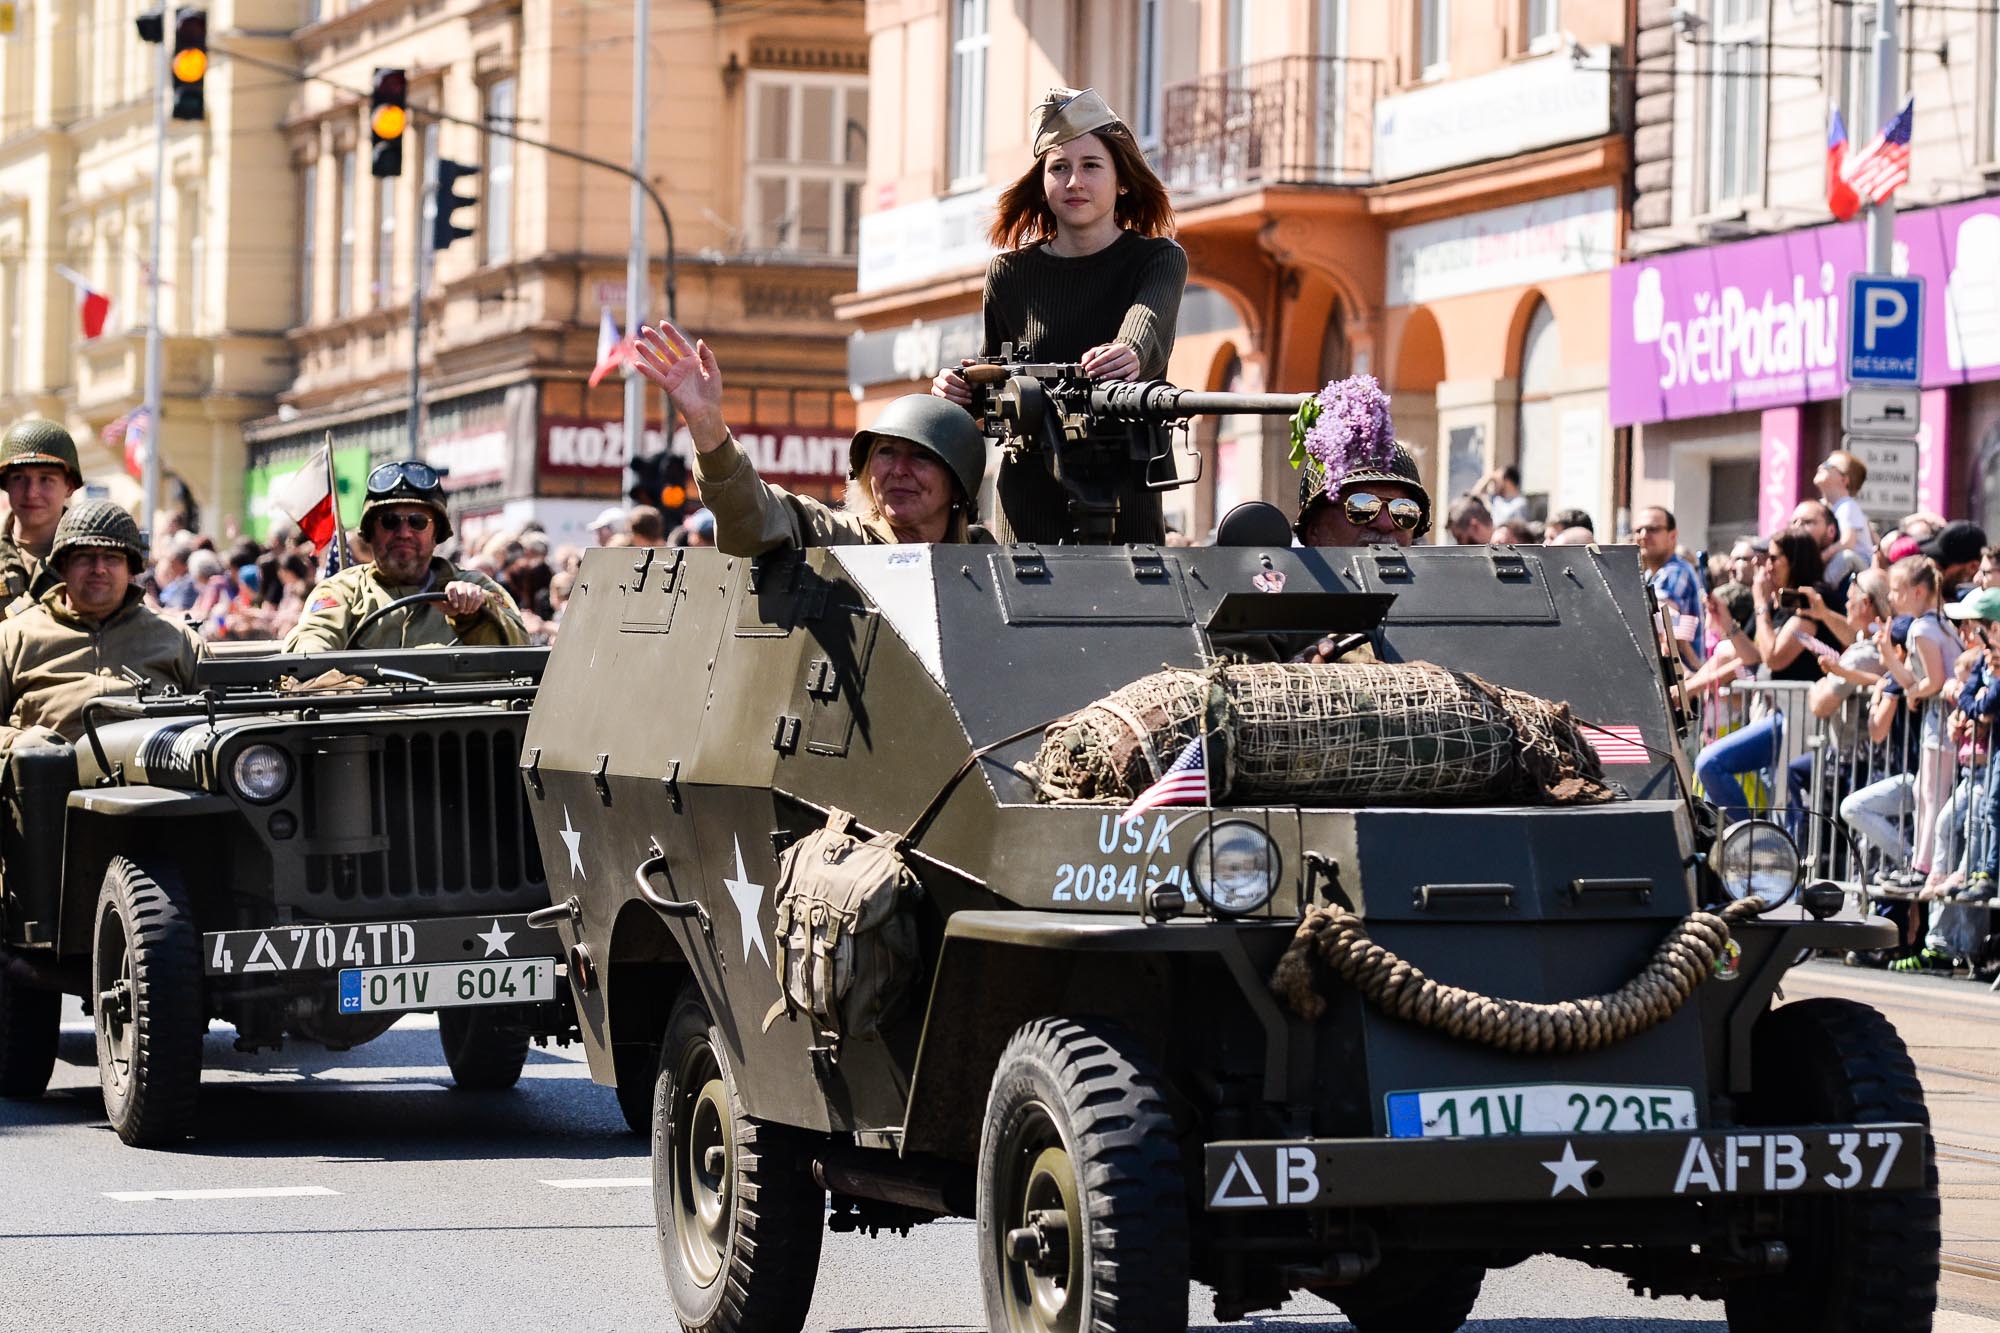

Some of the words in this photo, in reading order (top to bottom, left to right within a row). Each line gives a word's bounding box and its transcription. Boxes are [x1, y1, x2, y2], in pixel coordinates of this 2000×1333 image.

[1660, 261, 1839, 389] světPotahů
[1864, 287, 1908, 350] P
[1098, 814, 1171, 854] USA
[343, 997, 360, 1008] CZ
[370, 971, 430, 1006] 01V
[457, 965, 538, 1000] 6041
[1437, 1094, 1524, 1137] 11V
[1567, 1092, 1675, 1132] 2235
[1673, 1134, 1807, 1194] AFB
[1823, 1132, 1904, 1189] 37
